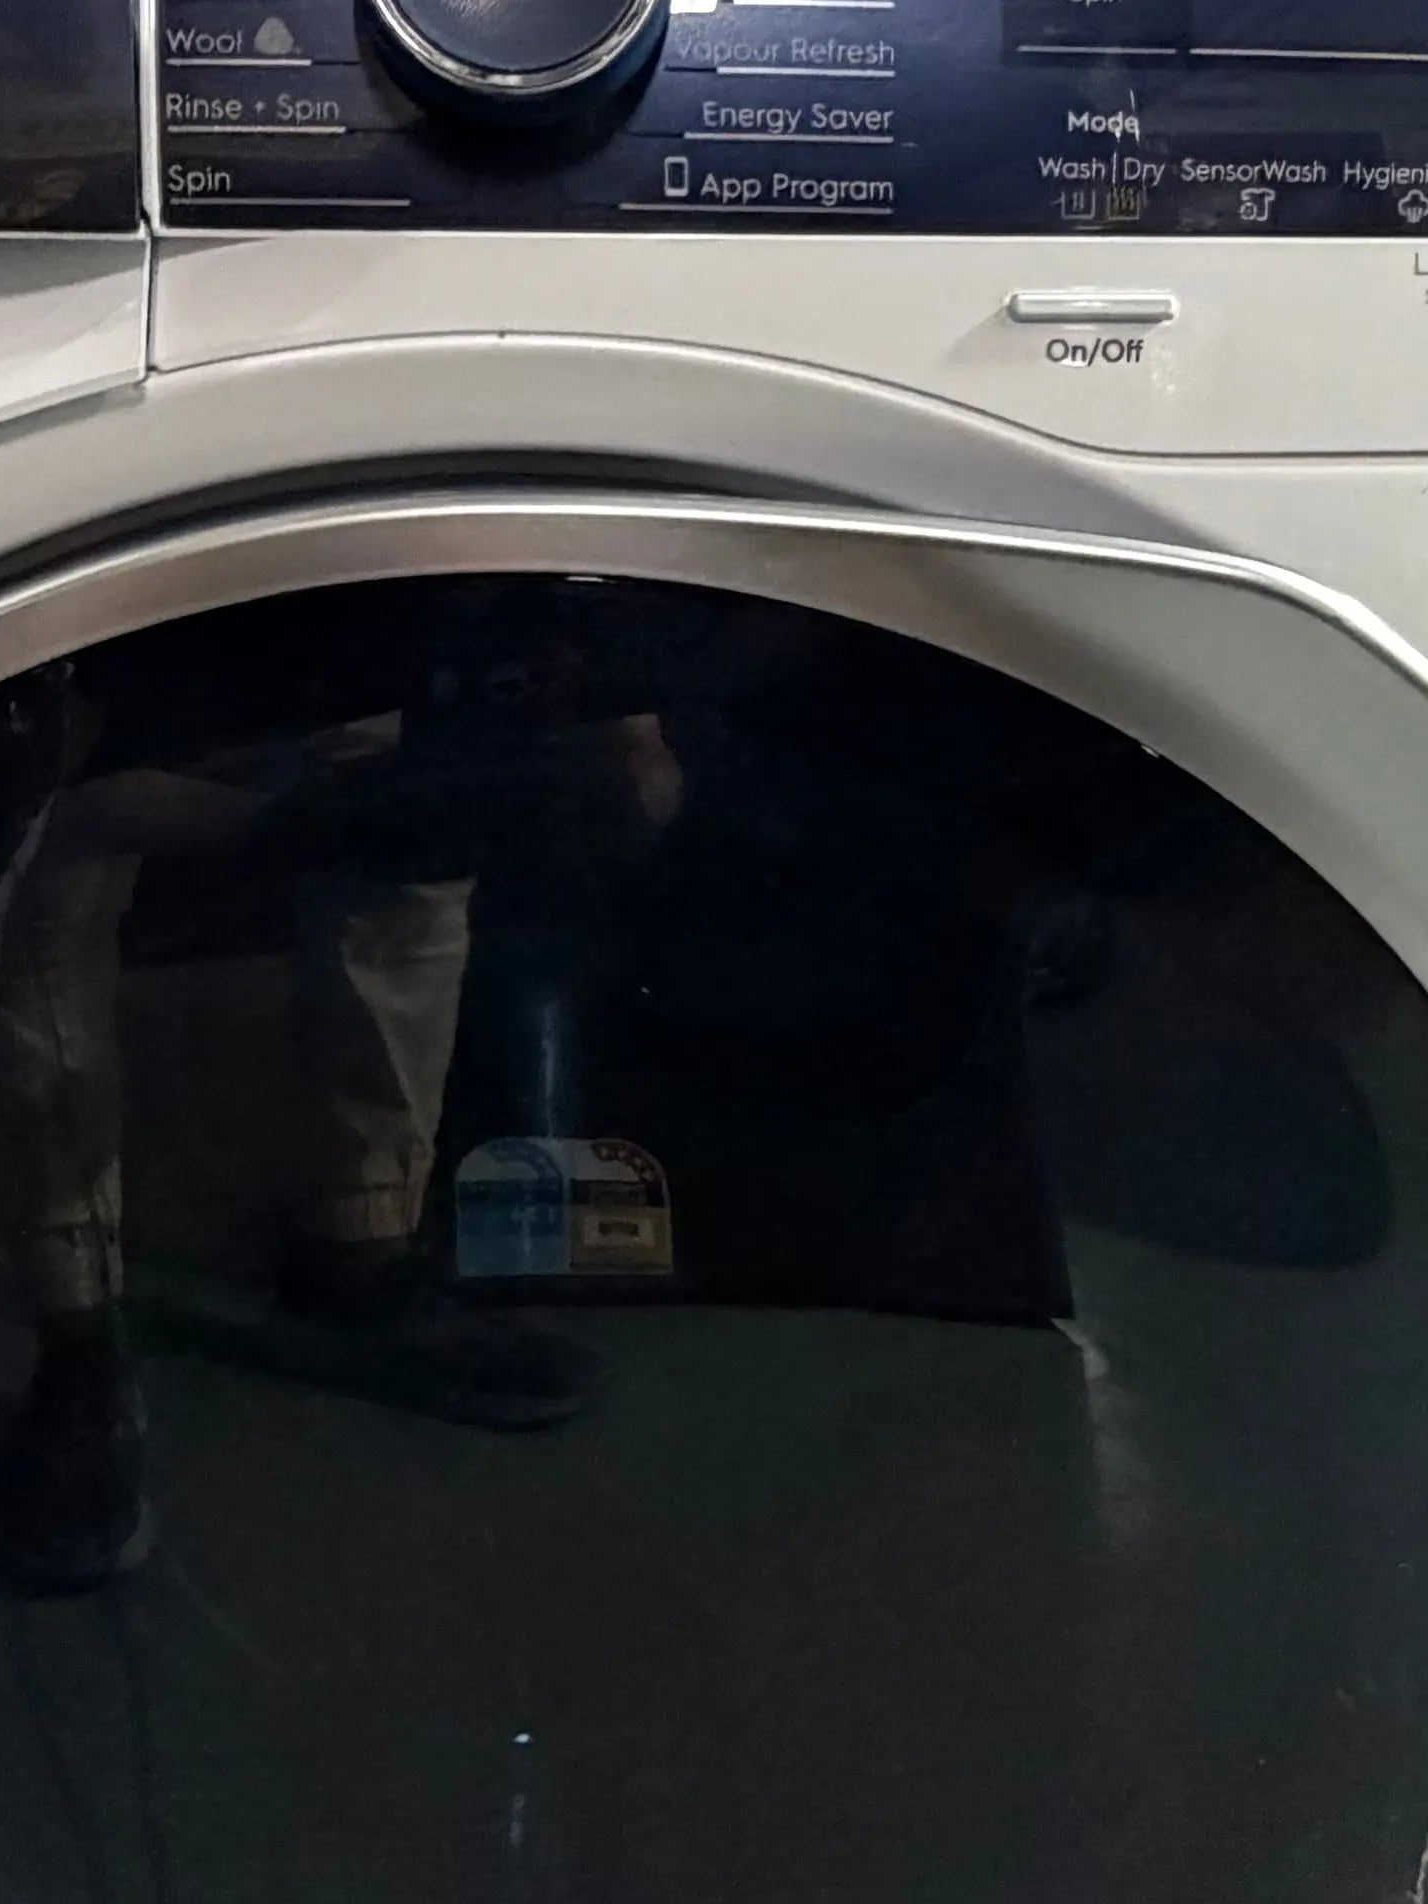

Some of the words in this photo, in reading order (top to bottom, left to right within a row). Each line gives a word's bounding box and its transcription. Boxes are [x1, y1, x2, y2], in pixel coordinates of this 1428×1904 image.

[165, 29, 244, 55] Wool
[677, 38, 778, 68] Vapour
[791, 38, 895, 66] Refresh
[166, 94, 240, 120] Rinse
[276, 95, 340, 126] Spin
[702, 102, 801, 134] Energy
[810, 103, 893, 131] Saver
[1067, 111, 1139, 139] Mode
[168, 165, 232, 196] Spin
[1038, 156, 1106, 180] Wash
[1124, 157, 1166, 187] Dry
[1179, 159, 1327, 184] SensorWash
[699, 174, 765, 208] App
[774, 174, 895, 209] Program
[1045, 338, 1144, 365] On/Off
